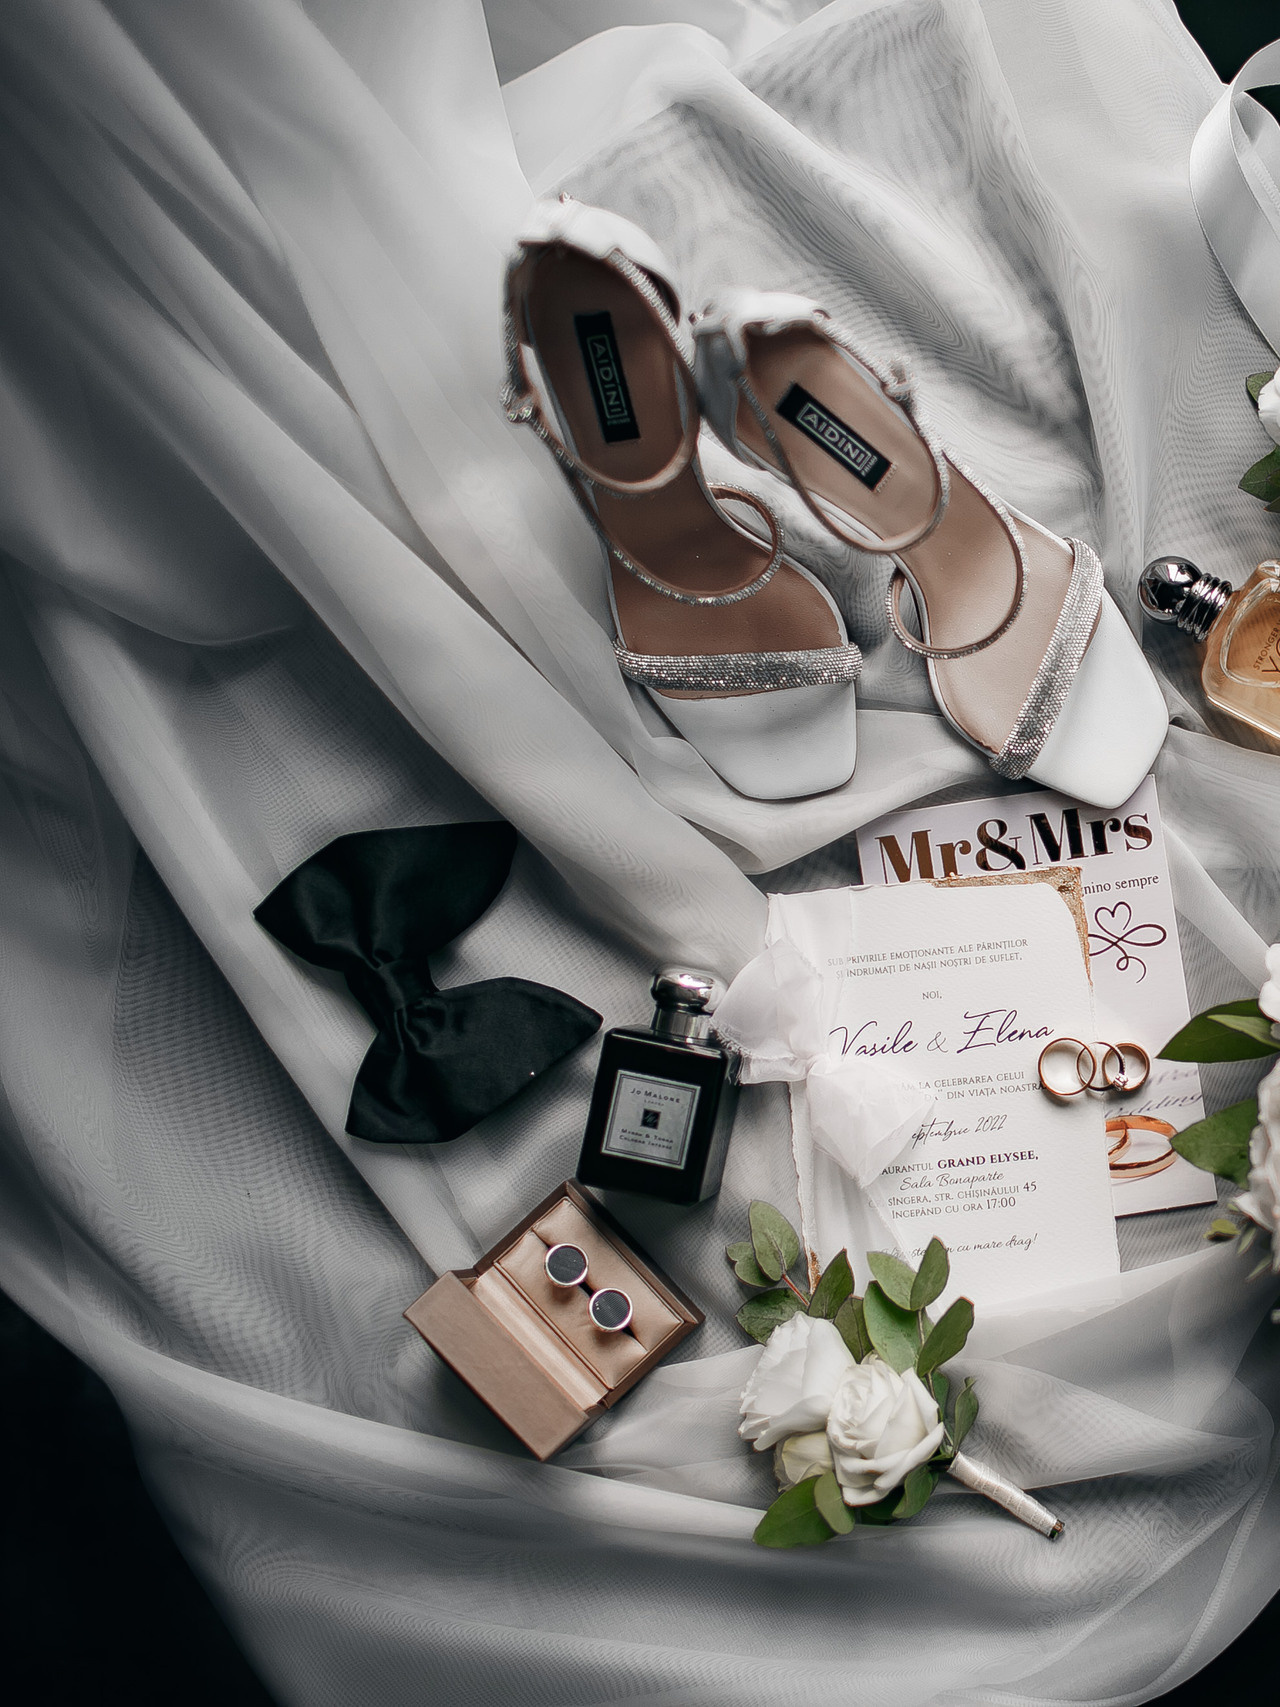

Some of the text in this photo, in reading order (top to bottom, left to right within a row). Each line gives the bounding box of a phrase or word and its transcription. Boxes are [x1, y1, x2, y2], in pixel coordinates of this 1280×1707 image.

[593, 340, 622, 417] AIDINI
[804, 412, 867, 467] AIDINI
[1252, 626, 1280, 671] STRONGER
[1083, 874, 1160, 897] nino sempre
[827, 957, 844, 967] SUB
[846, 953, 887, 965] PRIVIRILE
[957, 943, 974, 953] ALE
[899, 963, 911, 972] DE
[975, 955, 987, 965] DE
[829, 1009, 1055, 1058] Vasile & Elena
[918, 1081, 931, 1090] LA
[934, 1075, 993, 1088] CELEBRAREA
[996, 1071, 1025, 1082] CELUI
[947, 1088, 965, 1100] DIN
[911, 1114, 1008, 1150] eptembrie 2022
[881, 1150, 1039, 1176] AURANTUL GRAND ELYSEE,
[899, 1170, 1005, 1191] Sala Bonaparte
[934, 1192, 954, 1202] STR.
[1022, 1180, 1037, 1193] 45
[944, 1204, 960, 1214] CU
[962, 1202, 983, 1212] ORA
[986, 1196, 1017, 1210] 17:00
[956, 1244, 971, 1254] cu
[973, 1241, 1003, 1251] mare
[1005, 1232, 1038, 1251] drag!
